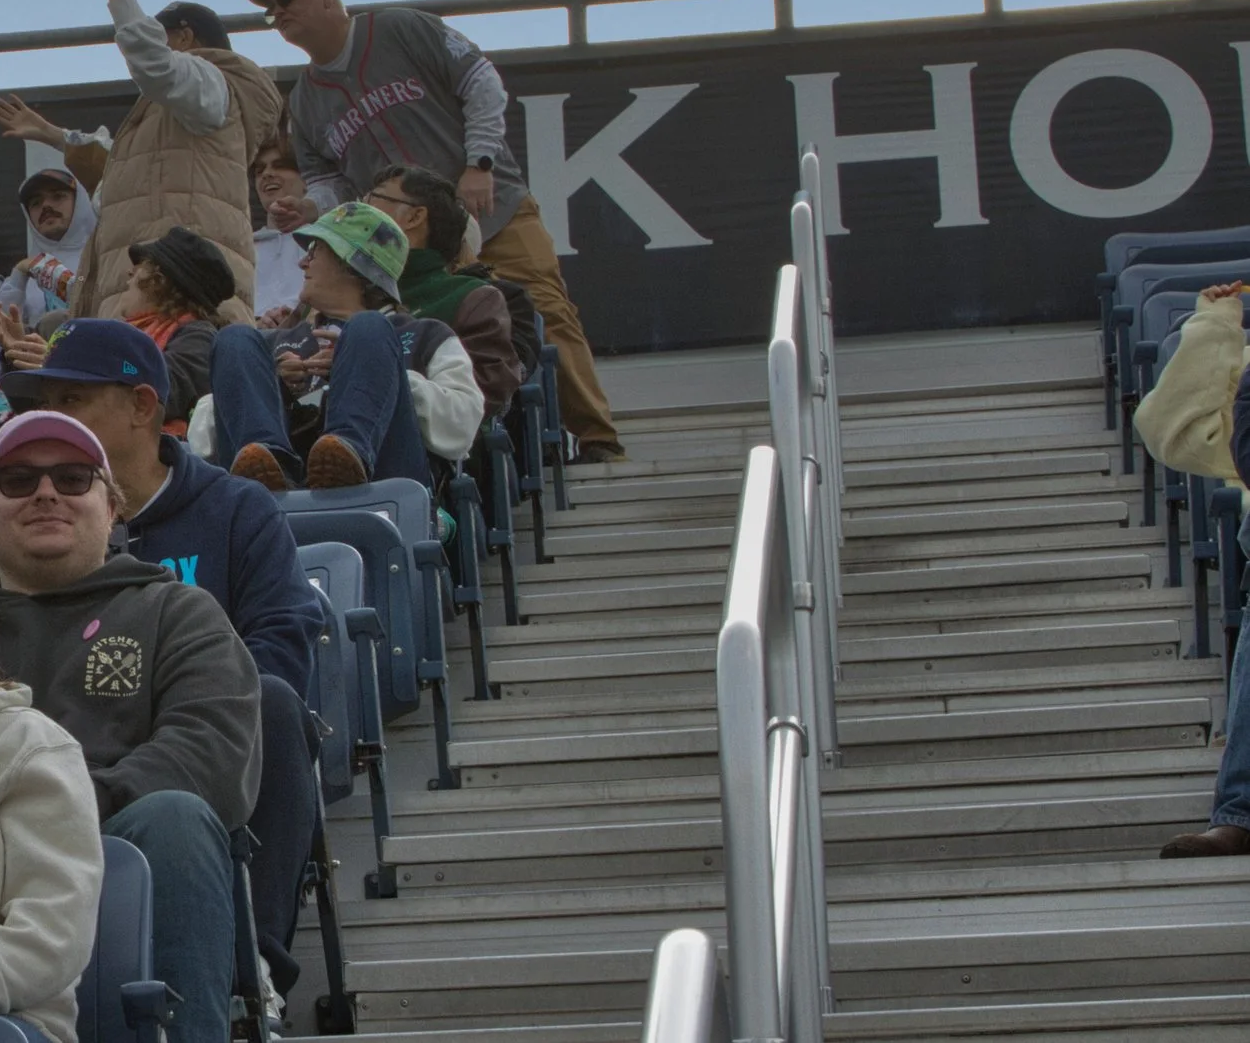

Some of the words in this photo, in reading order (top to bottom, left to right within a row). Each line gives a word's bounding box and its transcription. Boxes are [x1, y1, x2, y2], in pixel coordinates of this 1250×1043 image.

[326, 77, 425, 159] MARINERS
[785, 42, 1250, 236] HO
[84, 655, 96, 690] ARIES
[91, 636, 139, 652] KITCHEN
